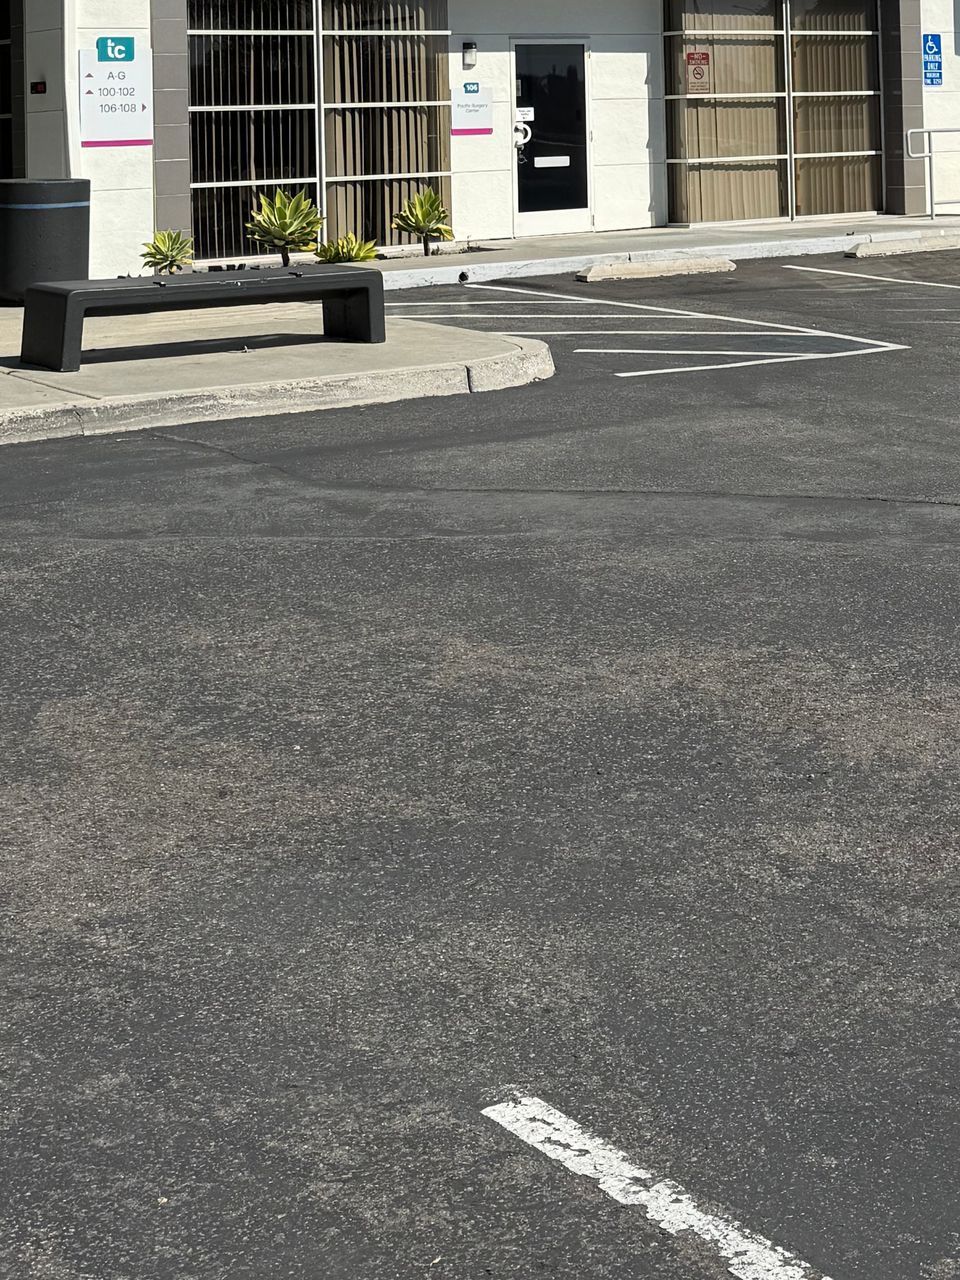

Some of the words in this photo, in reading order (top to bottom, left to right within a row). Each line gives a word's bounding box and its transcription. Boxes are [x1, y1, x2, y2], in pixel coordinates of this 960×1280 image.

[107, 39, 126, 58] tc
[98, 87, 135, 97] 100-102
[100, 104, 136, 113] 106-108
